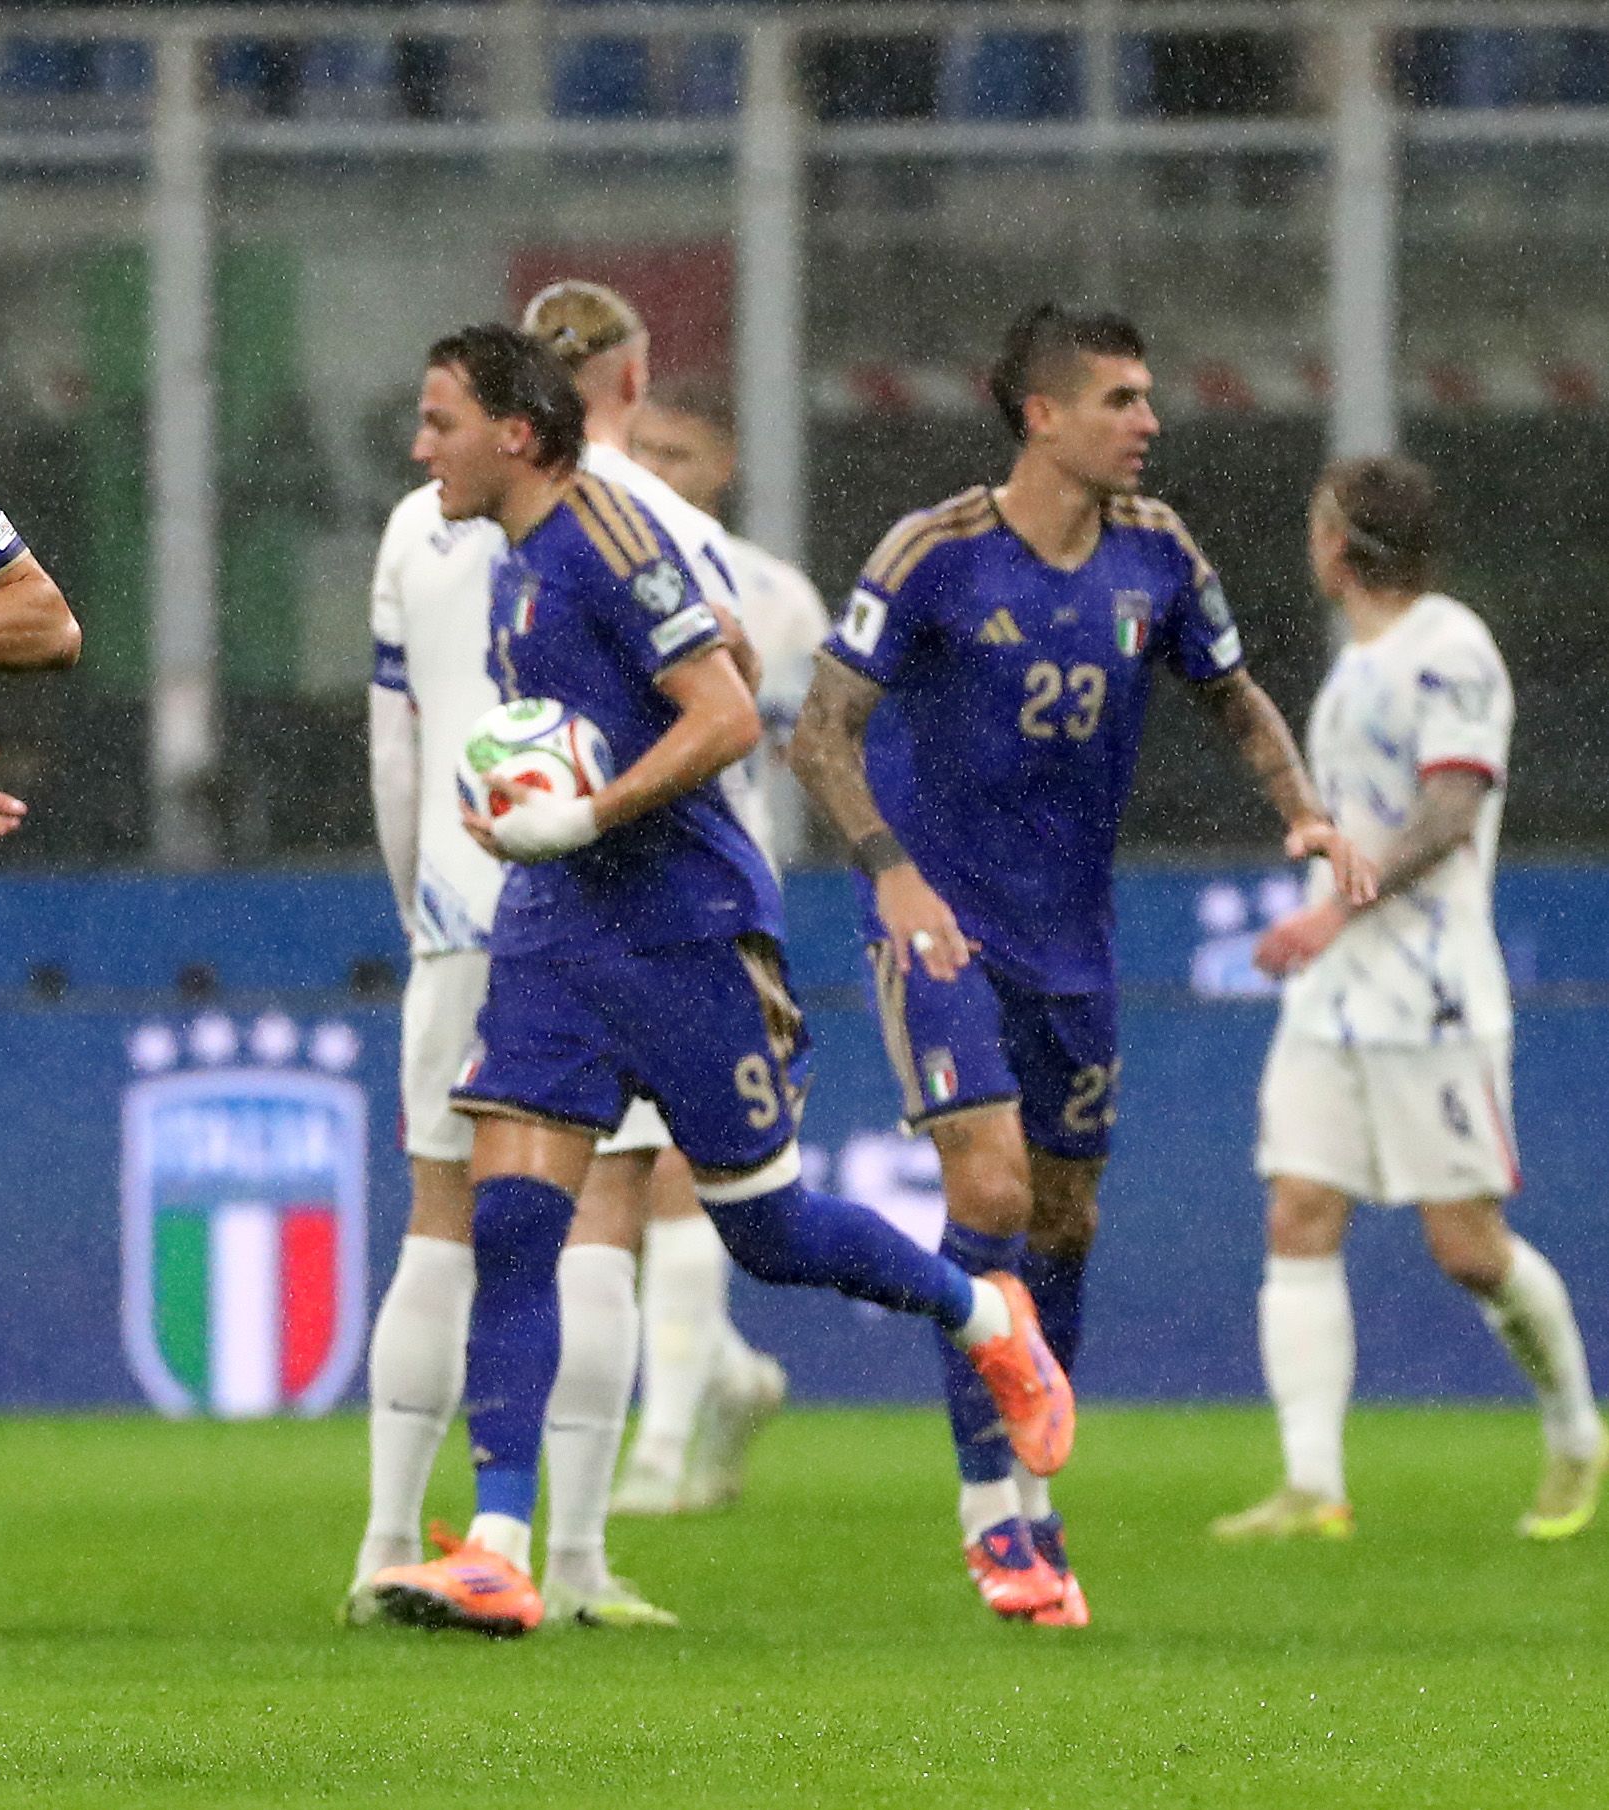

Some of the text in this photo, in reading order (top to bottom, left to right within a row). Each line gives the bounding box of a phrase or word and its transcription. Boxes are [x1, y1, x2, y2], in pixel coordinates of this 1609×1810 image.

[1019, 662, 1107, 741] 23
[734, 1052, 779, 1130] 9
[1063, 1056, 1123, 1132] 2
